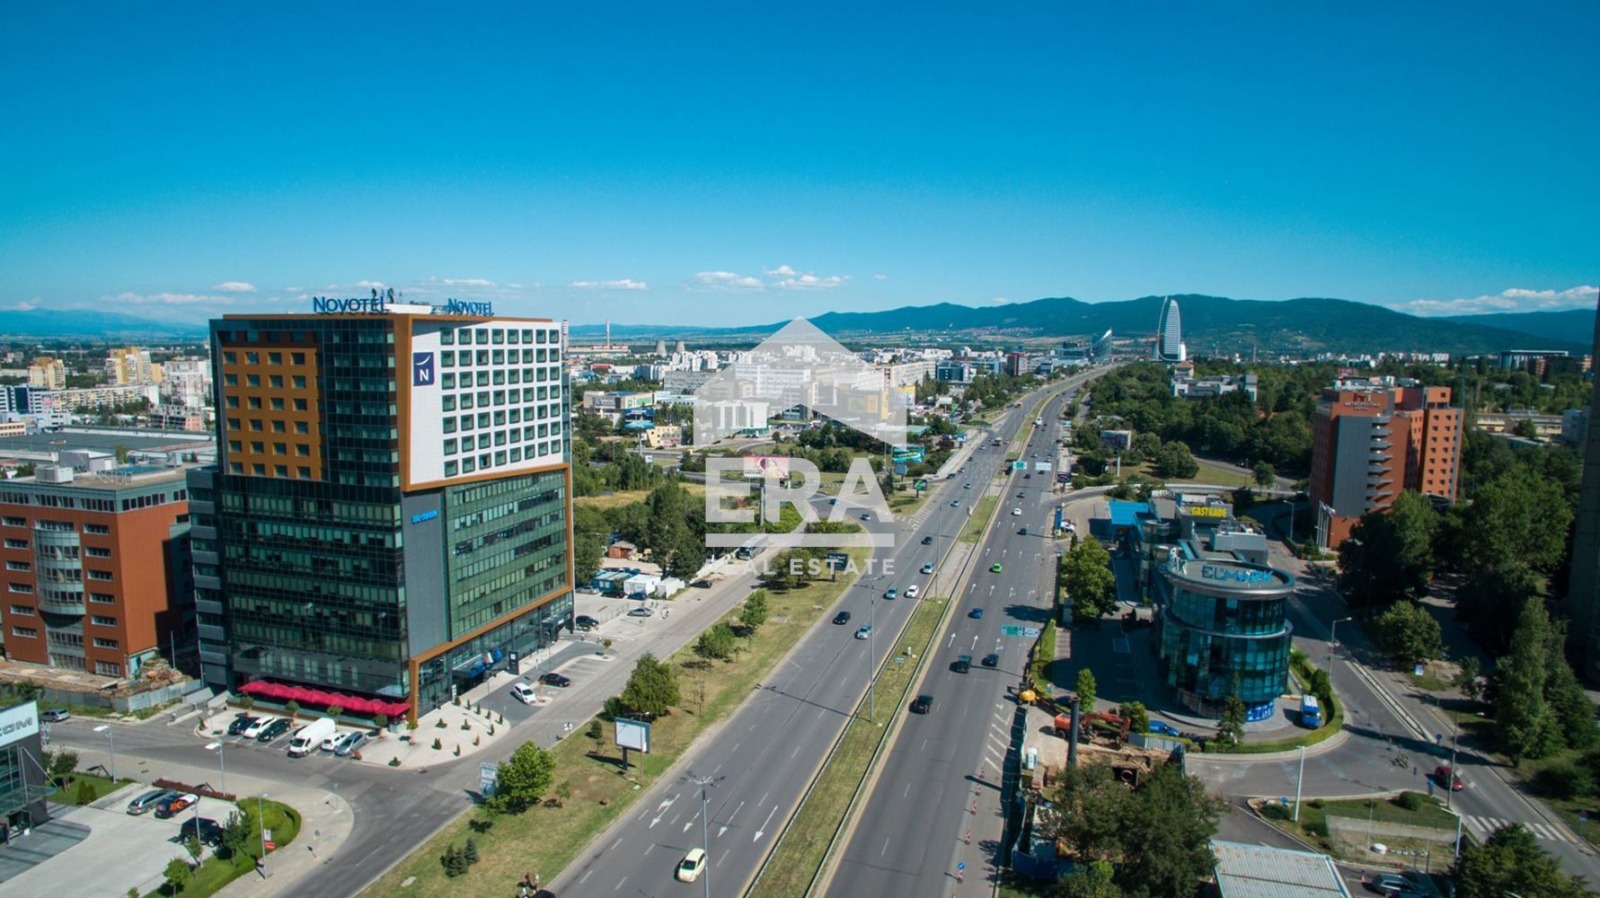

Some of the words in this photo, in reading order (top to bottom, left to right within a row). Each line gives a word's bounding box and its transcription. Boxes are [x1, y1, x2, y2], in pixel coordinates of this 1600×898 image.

[313, 296, 386, 312] NOVOTEL
[448, 298, 492, 314] NOVOTEL
[419, 368, 429, 381] N
[0, 717, 33, 737] OM
